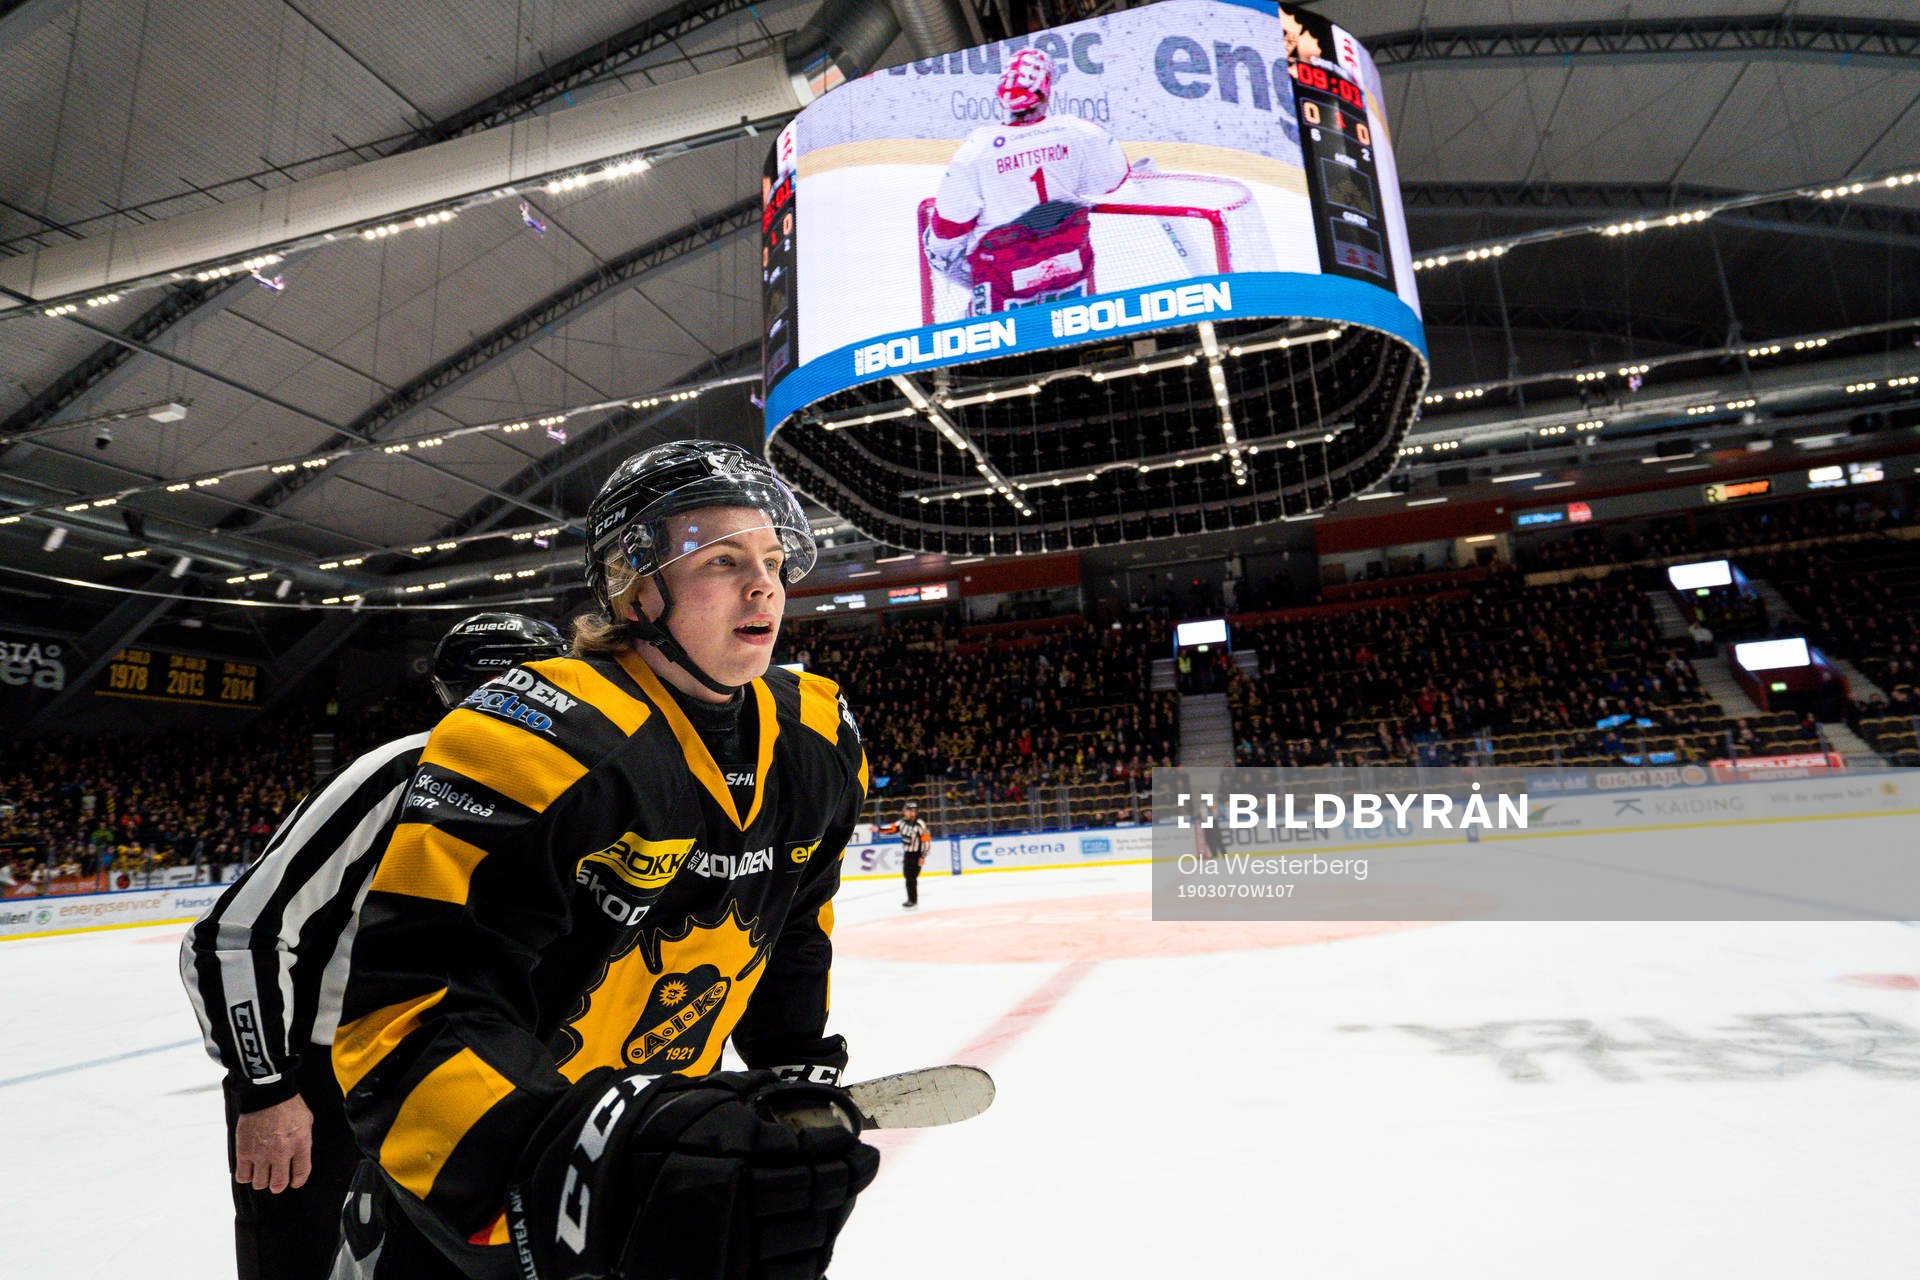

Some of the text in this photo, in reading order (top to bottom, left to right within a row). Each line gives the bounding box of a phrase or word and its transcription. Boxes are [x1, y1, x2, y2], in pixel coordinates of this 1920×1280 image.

[996, 144, 1069, 174] BRATTSTRÖM
[1029, 166, 1048, 205] 1
[1062, 281, 1232, 337] BOLIDEN
[863, 318, 1017, 374] BOLIDEN
[594, 506, 628, 536] CCM
[109, 664, 149, 690] 1978
[166, 670, 206, 697] 2013
[725, 772, 755, 786] SHL
[415, 774, 496, 818] Skellefteå
[1655, 796, 1745, 817] KAIDING
[995, 842, 1066, 858] extena
[59, 898, 162, 917] energiservice
[234, 1006, 269, 1075] CCM
[665, 1047, 695, 1061] 1921
[769, 1064, 843, 1088] CC
